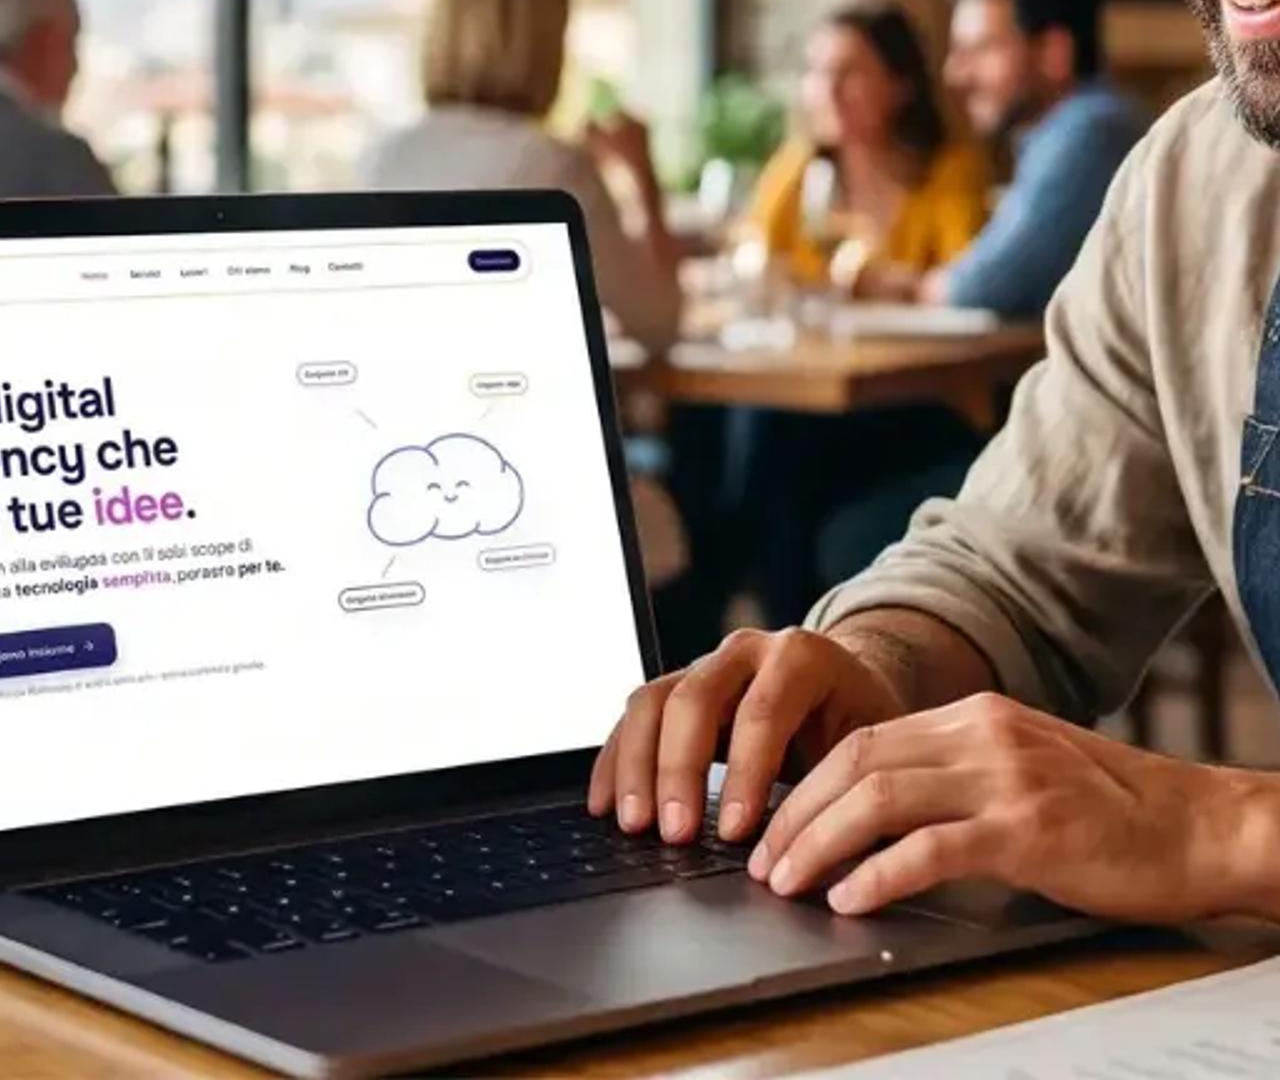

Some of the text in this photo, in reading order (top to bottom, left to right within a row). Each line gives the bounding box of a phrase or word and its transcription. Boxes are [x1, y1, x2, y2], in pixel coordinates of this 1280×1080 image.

[97, 430, 178, 470] che
[7, 497, 83, 533] tue
[93, 486, 196, 525] idee.
[111, 551, 140, 564] con
[15, 576, 98, 596] tecnologia
[238, 563, 262, 578] per
